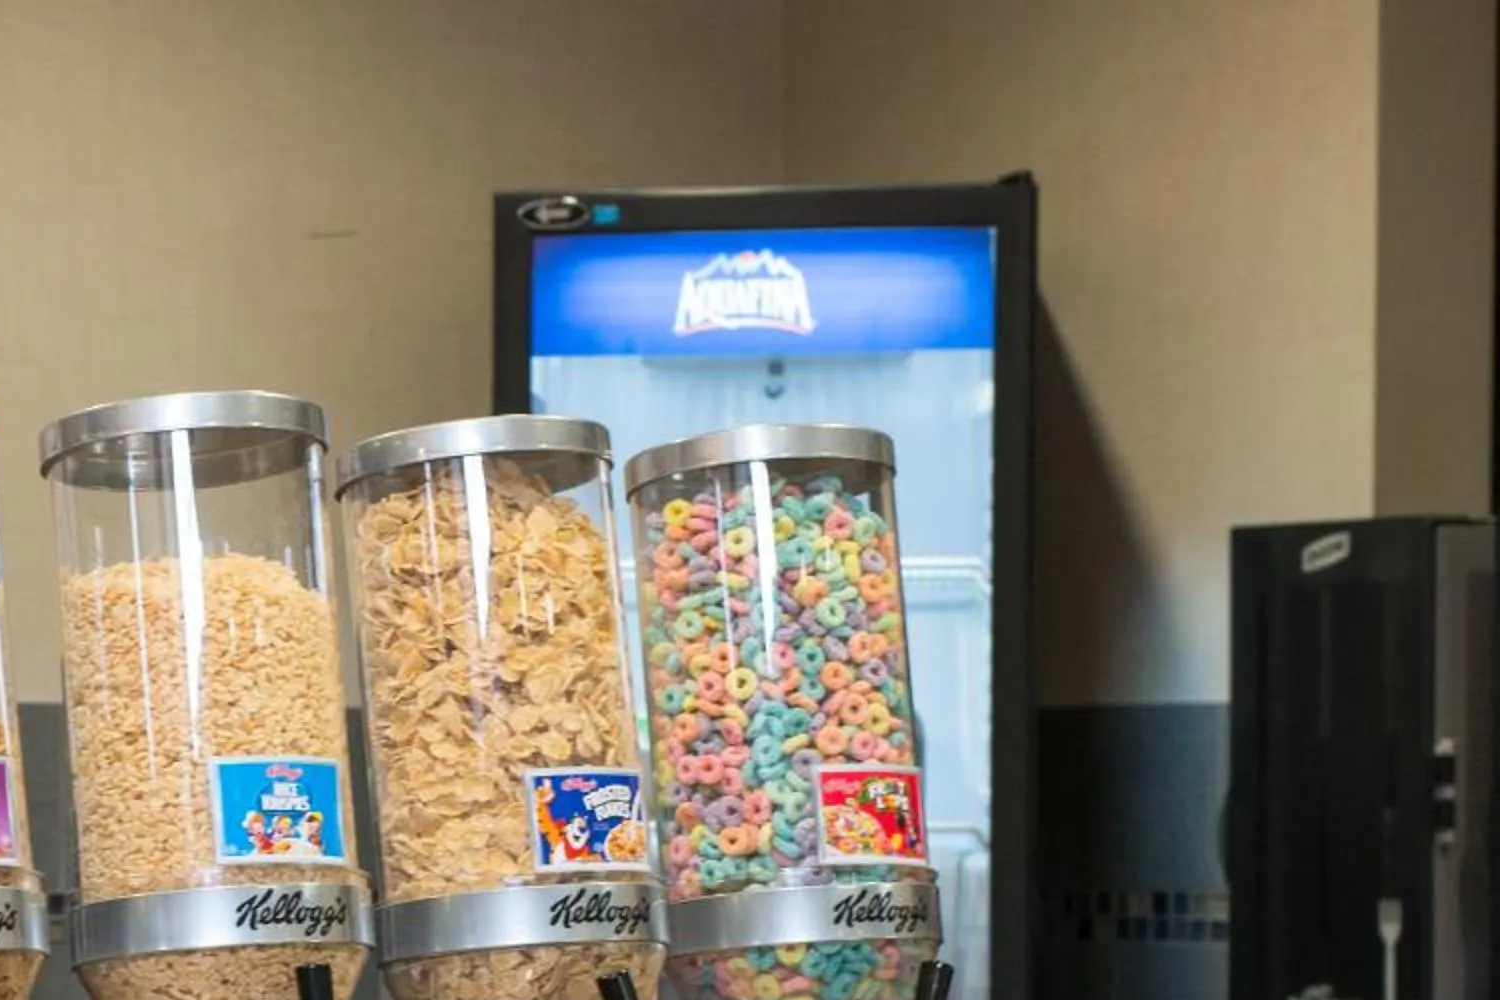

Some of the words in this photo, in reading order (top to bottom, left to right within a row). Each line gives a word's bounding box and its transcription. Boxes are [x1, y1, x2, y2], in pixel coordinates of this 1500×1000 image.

[236, 888, 347, 936] Kellogg's
[550, 888, 650, 934] Kellogg's
[833, 889, 928, 933] Kellogg's
